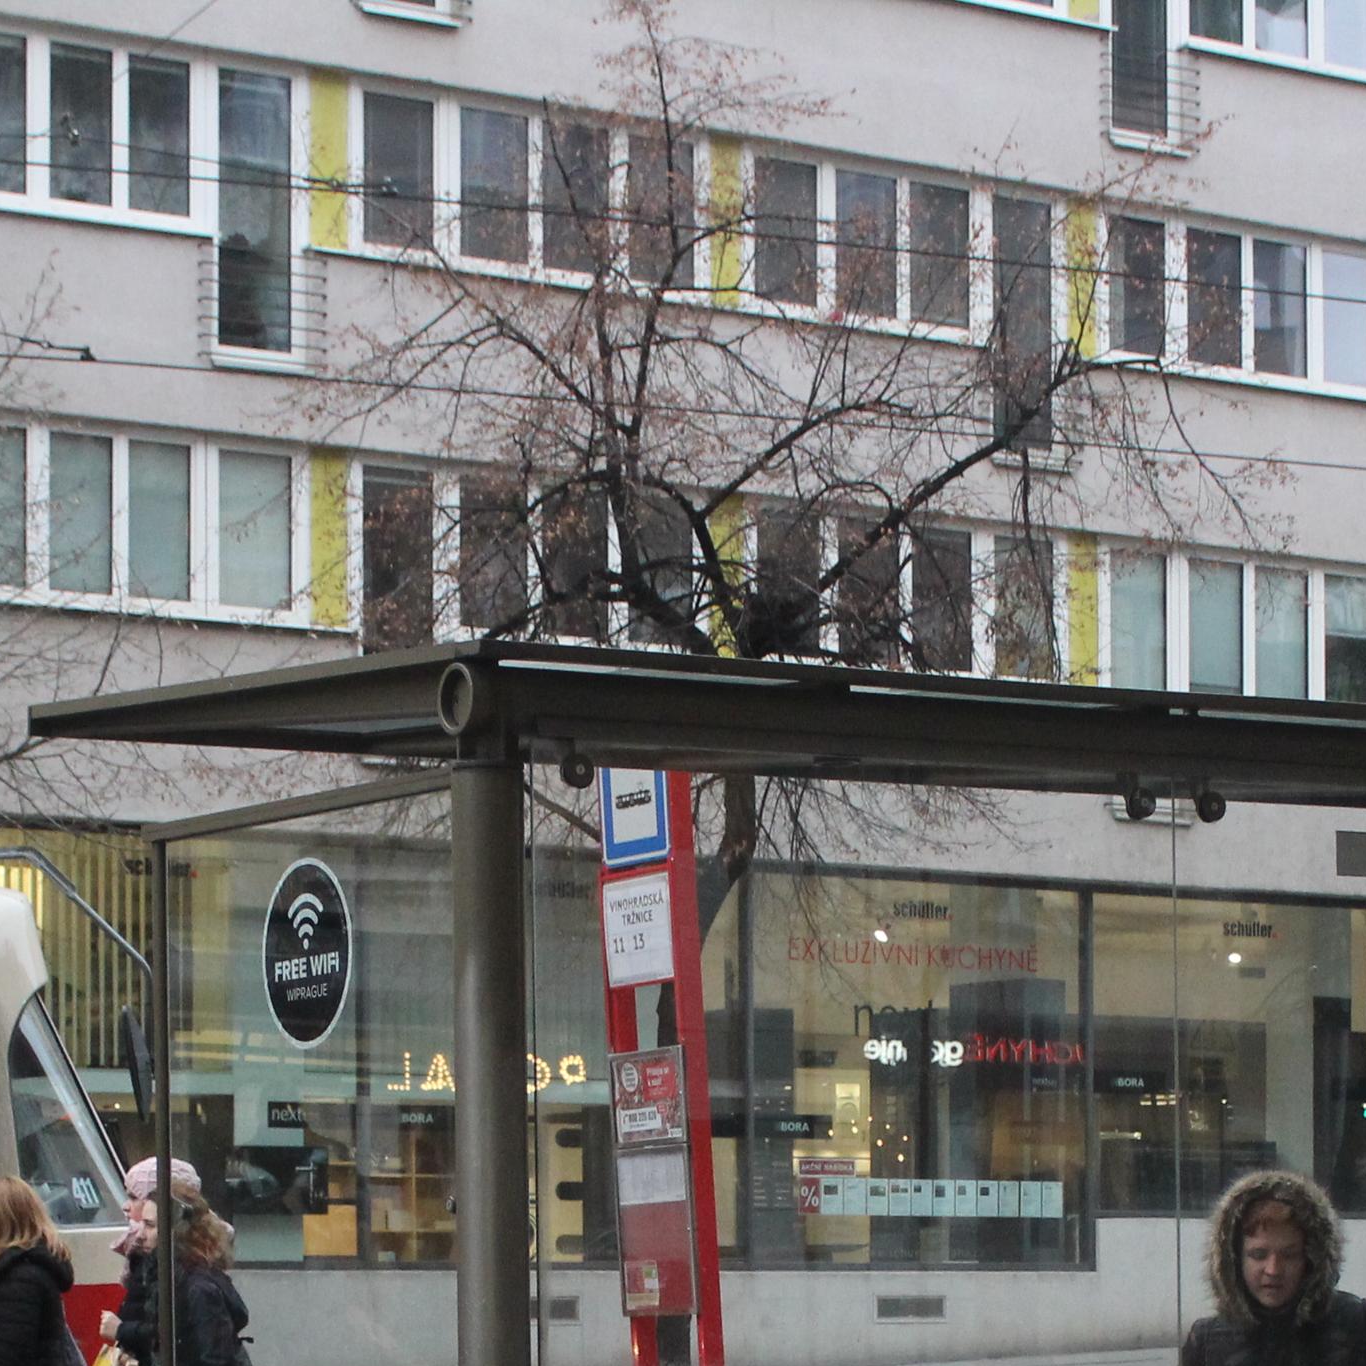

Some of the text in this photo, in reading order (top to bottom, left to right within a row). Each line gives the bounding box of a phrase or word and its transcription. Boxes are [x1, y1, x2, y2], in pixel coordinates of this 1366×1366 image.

[610, 889, 663, 912] VINOHRADSKÁ
[622, 910, 653, 926] TRŽNICE
[614, 933, 645, 953] 11 13
[789, 936, 919, 967] EXKLUZIVNÍ
[275, 951, 340, 983] FREE WIFI
[287, 983, 328, 1001] WIPRAGUE
[1115, 1077, 1144, 1087] BORA
[401, 1112, 434, 1123] BORA
[780, 1121, 810, 1132] BORA
